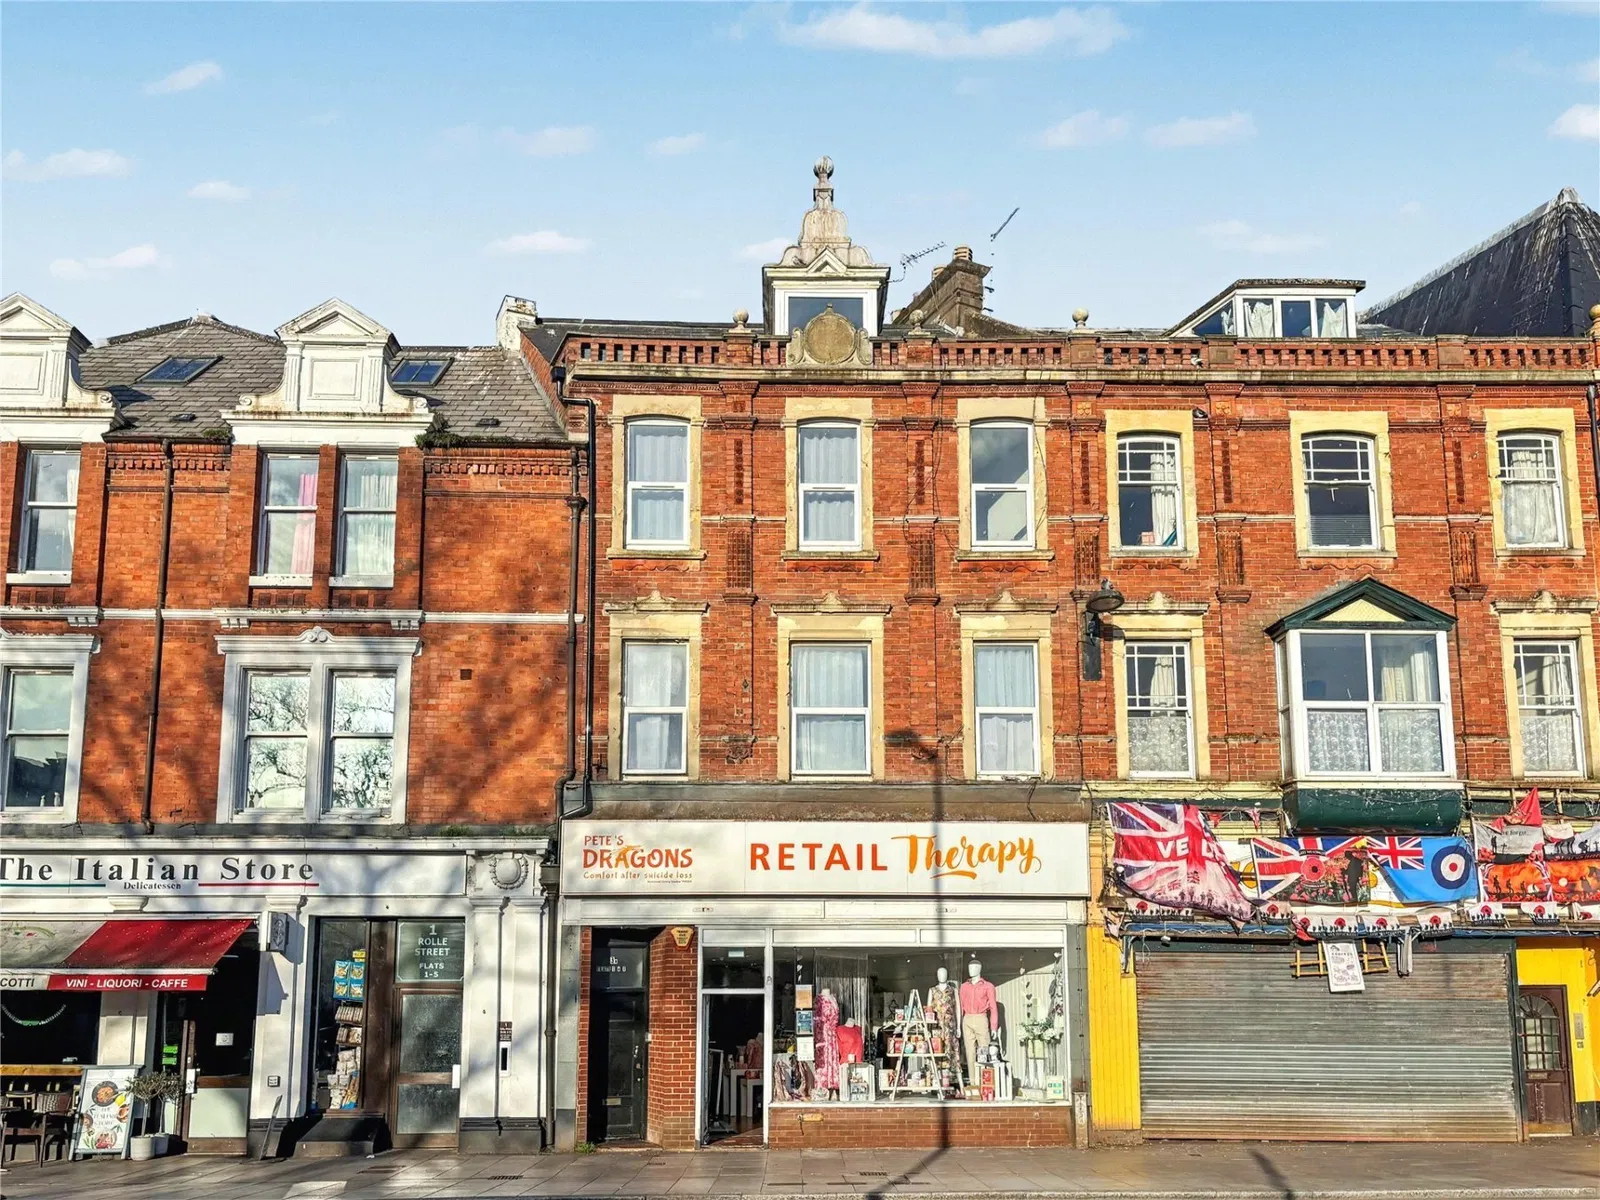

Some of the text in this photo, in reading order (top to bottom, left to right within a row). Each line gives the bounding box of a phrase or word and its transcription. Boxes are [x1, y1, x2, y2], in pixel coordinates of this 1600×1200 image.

[584, 835, 624, 846] PETE'S
[1156, 836, 1190, 859] VE
[582, 848, 693, 869] DRAGONS
[750, 834, 1042, 875] RETAIL Therapy
[0, 857, 313, 881] The Italian Store
[583, 871, 692, 880] Comfort after suicide loss
[123, 881, 181, 891] Delicatessen
[429, 924, 437, 936] 1
[418, 937, 448, 946] ROLLE
[414, 947, 450, 956] STREET
[419, 962, 445, 970] FLATS
[0, 978, 35, 988] COTTI
[66, 978, 87, 988] VINI
[97, 978, 142, 988] LIQUORI
[152, 978, 188, 988] CAFFE
